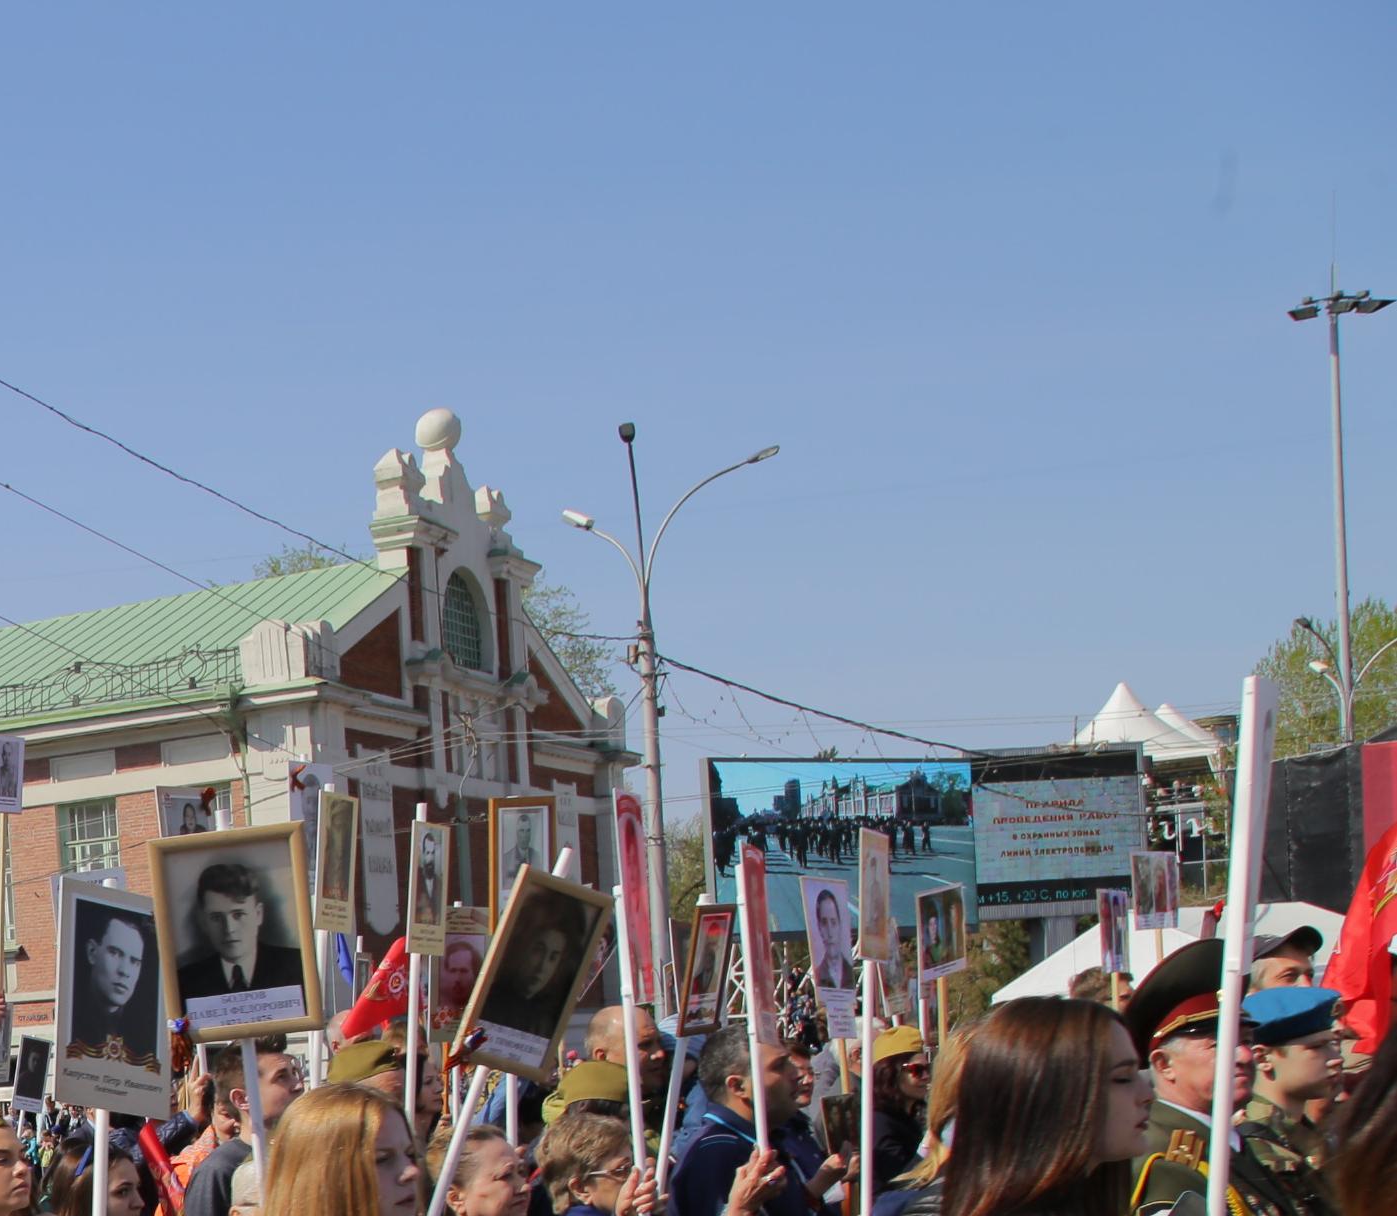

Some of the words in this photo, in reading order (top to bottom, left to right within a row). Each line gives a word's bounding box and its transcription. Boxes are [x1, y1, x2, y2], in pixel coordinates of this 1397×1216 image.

[993, 814, 1074, 825] ПРОВЕДЕНИЯ
[1020, 831, 1069, 840] ОХРАННЫХ
[1072, 829, 1101, 838] ЗОНАХ
[1000, 848, 1032, 858] ЛИНИЙ
[1035, 845, 1114, 857] ЭЛЕКТРОПЕРЕДАЧ
